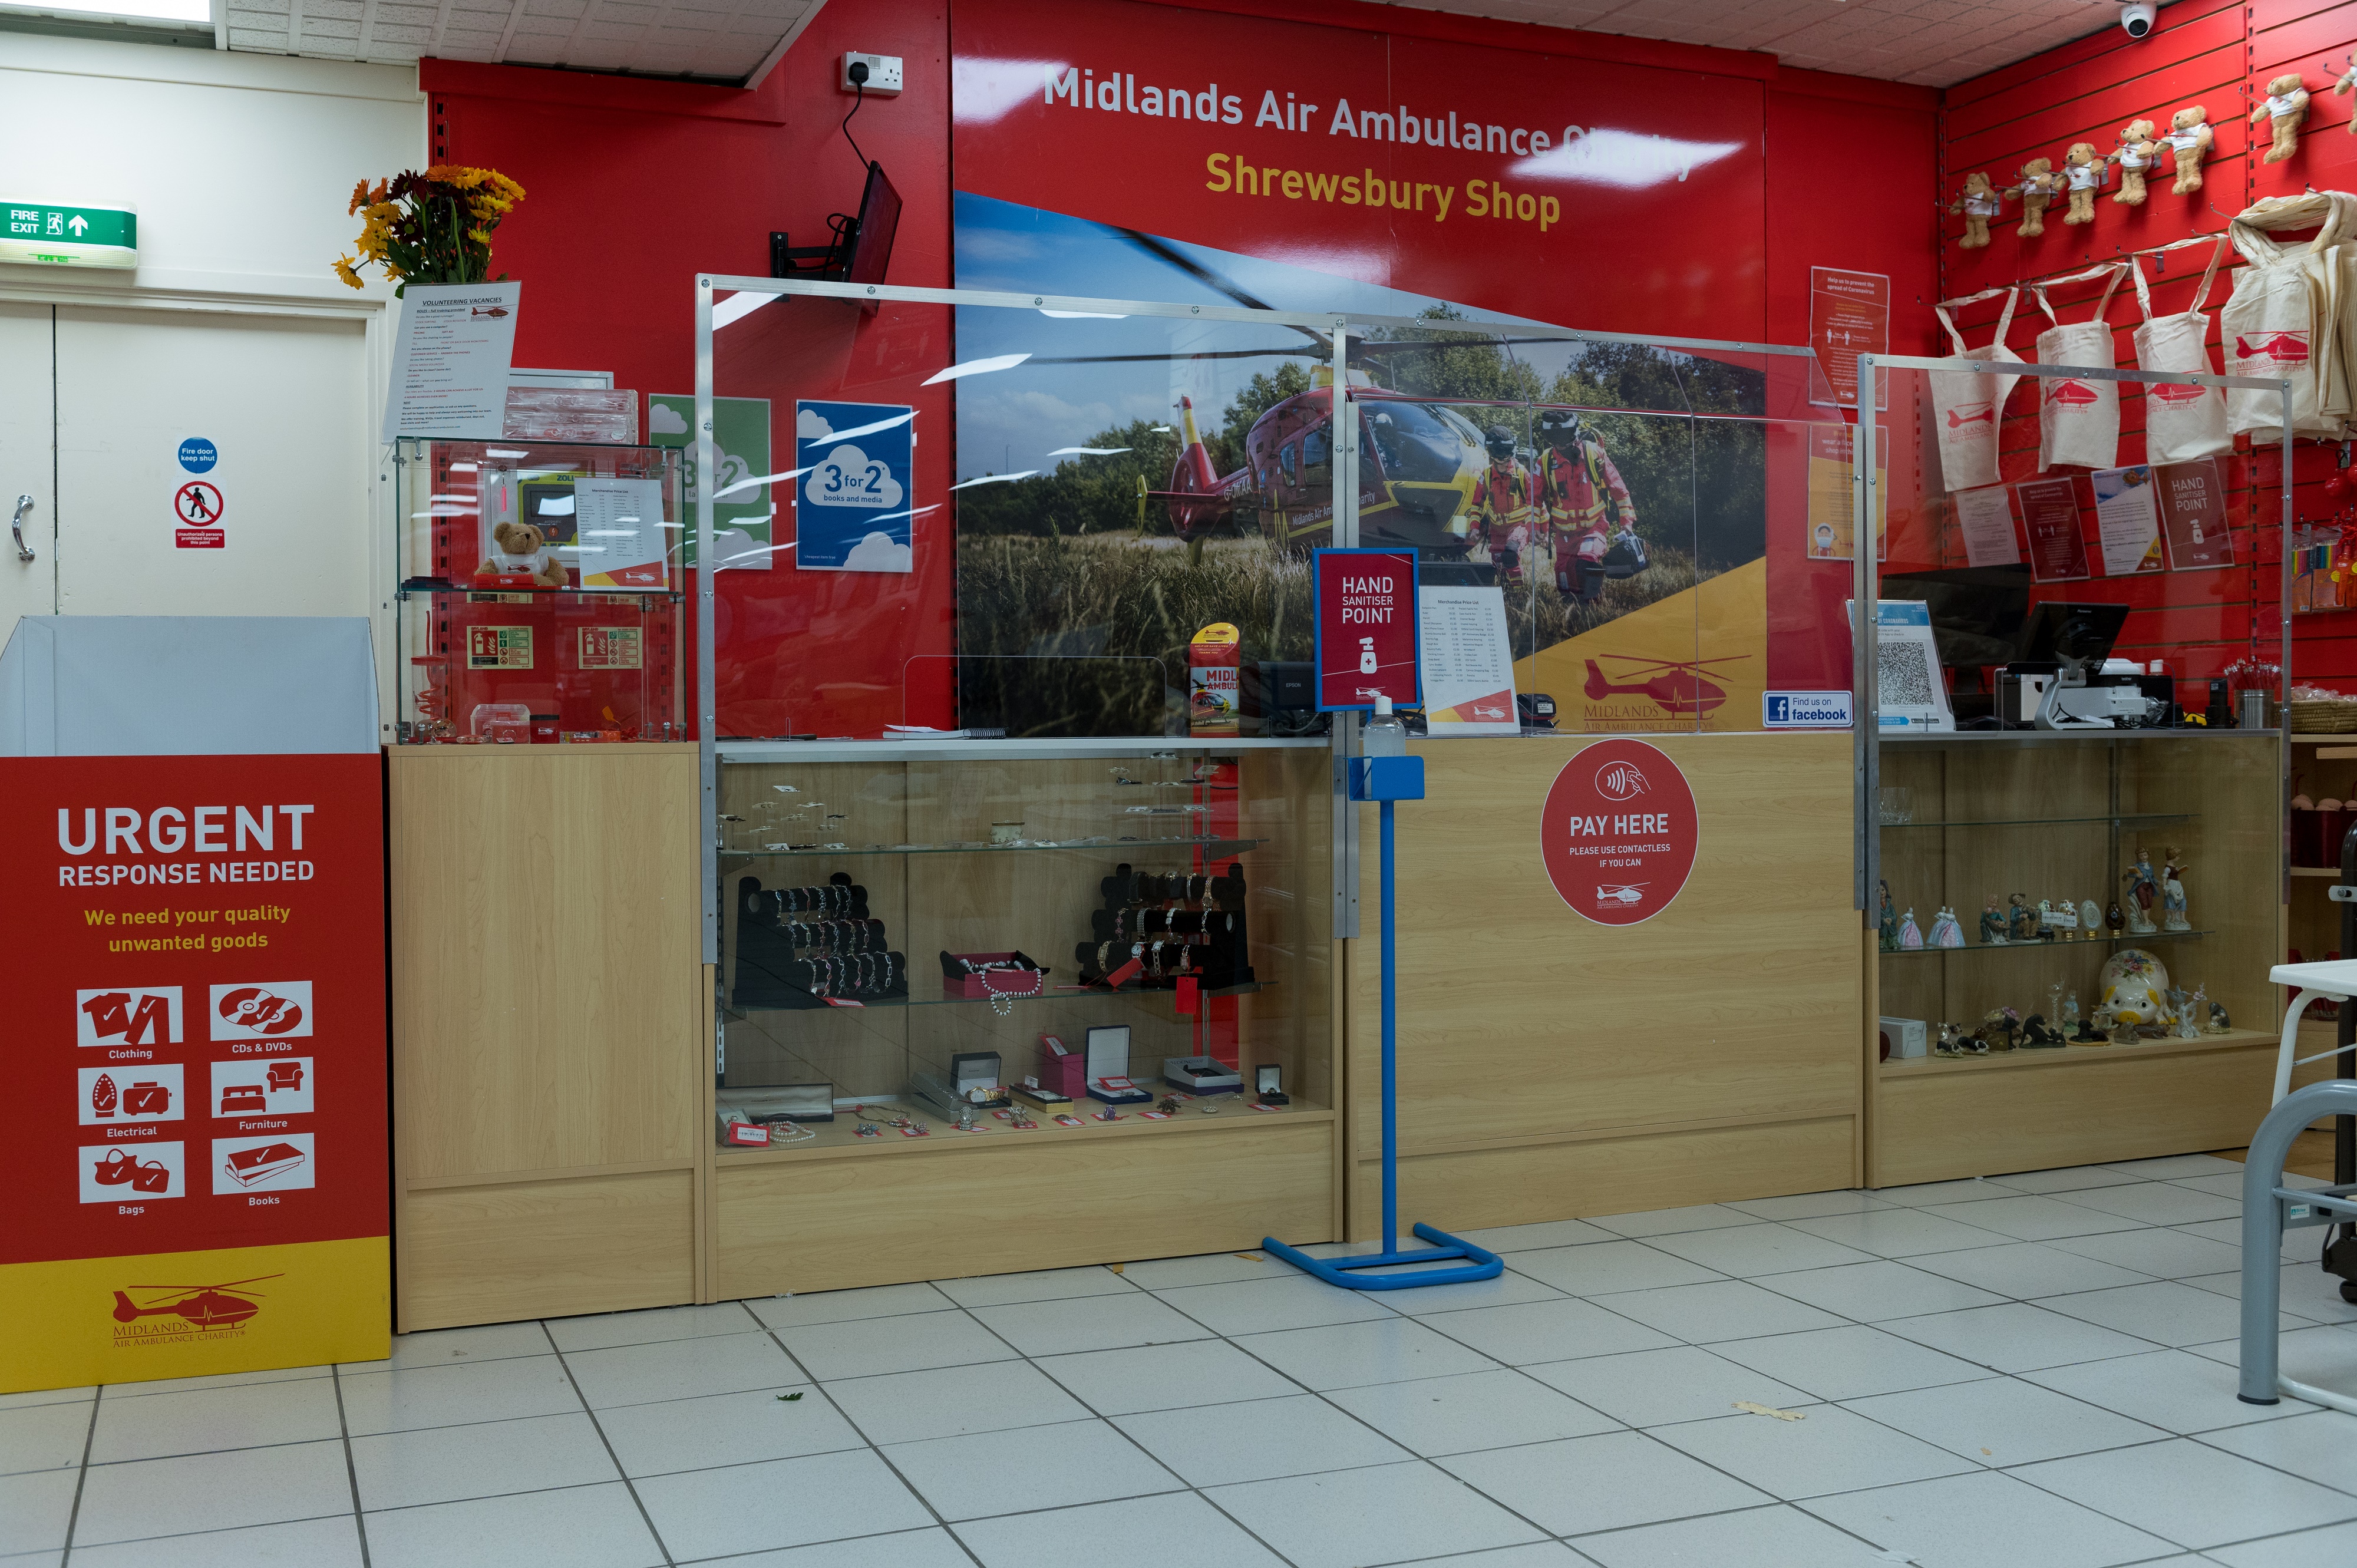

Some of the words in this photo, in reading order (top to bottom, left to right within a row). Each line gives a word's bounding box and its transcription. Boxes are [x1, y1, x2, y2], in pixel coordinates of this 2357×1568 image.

[1044, 67, 1243, 126] Midlands
[1256, 90, 1318, 134] Air
[1330, 97, 1550, 158] Ambulance
[1206, 152, 1454, 222] Shrewsbury
[1466, 180, 1560, 232] Shop
[11, 210, 39, 221] FIRE
[11, 223, 39, 233] EXIT
[2237, 358, 2270, 369] MIDLANDS
[1949, 425, 1991, 436] MIDLANDS
[825, 464, 841, 493] 3
[844, 475, 864, 487] for
[2172, 477, 2204, 491] HAND
[824, 494, 845, 503] books
[861, 495, 882, 503] media
[2174, 490, 2206, 500] SANITISER
[2176, 498, 2207, 511] POINT
[1293, 512, 1314, 526] Midlands
[1342, 577, 1394, 594] HAND
[1342, 596, 1394, 606] SANITISER
[1342, 608, 1394, 624] POINT
[1792, 696, 1810, 706] Find
[1584, 705, 1659, 717] MIDLANDS
[1792, 708, 1847, 721] facebook
[1584, 722, 1600, 731] AIR
[1605, 722, 1663, 731] AMBULANCE
[58, 804, 315, 855] URGENT
[1570, 816, 1610, 836] PAY
[1614, 813, 1669, 835] HERE
[1569, 846, 1599, 855] PLEASE
[1600, 846, 1616, 854] USE
[1617, 844, 1671, 854] CONTACTLESS
[1625, 858, 1642, 867] CAN
[60, 863, 201, 887] RESPONSE
[210, 860, 314, 883] NEEDED
[84, 909, 115, 925] We
[122, 908, 169, 925] need
[174, 909, 219, 926] your
[225, 905, 291, 926] quality
[109, 934, 205, 952] unwanted
[211, 932, 268, 952] goods
[232, 1044, 252, 1054] CDs
[254, 1043, 263, 1052] &
[265, 1042, 292, 1051] DVDs
[108, 1048, 153, 1061] Clothing
[239, 1119, 288, 1130] Furniture
[107, 1126, 157, 1138] Electrical
[249, 1196, 280, 1206] Books
[118, 1206, 144, 1216] Bags
[113, 1321, 189, 1337] MIDLANDS
[113, 1339, 131, 1348] AIR
[134, 1334, 194, 1346] AMBULANCE
